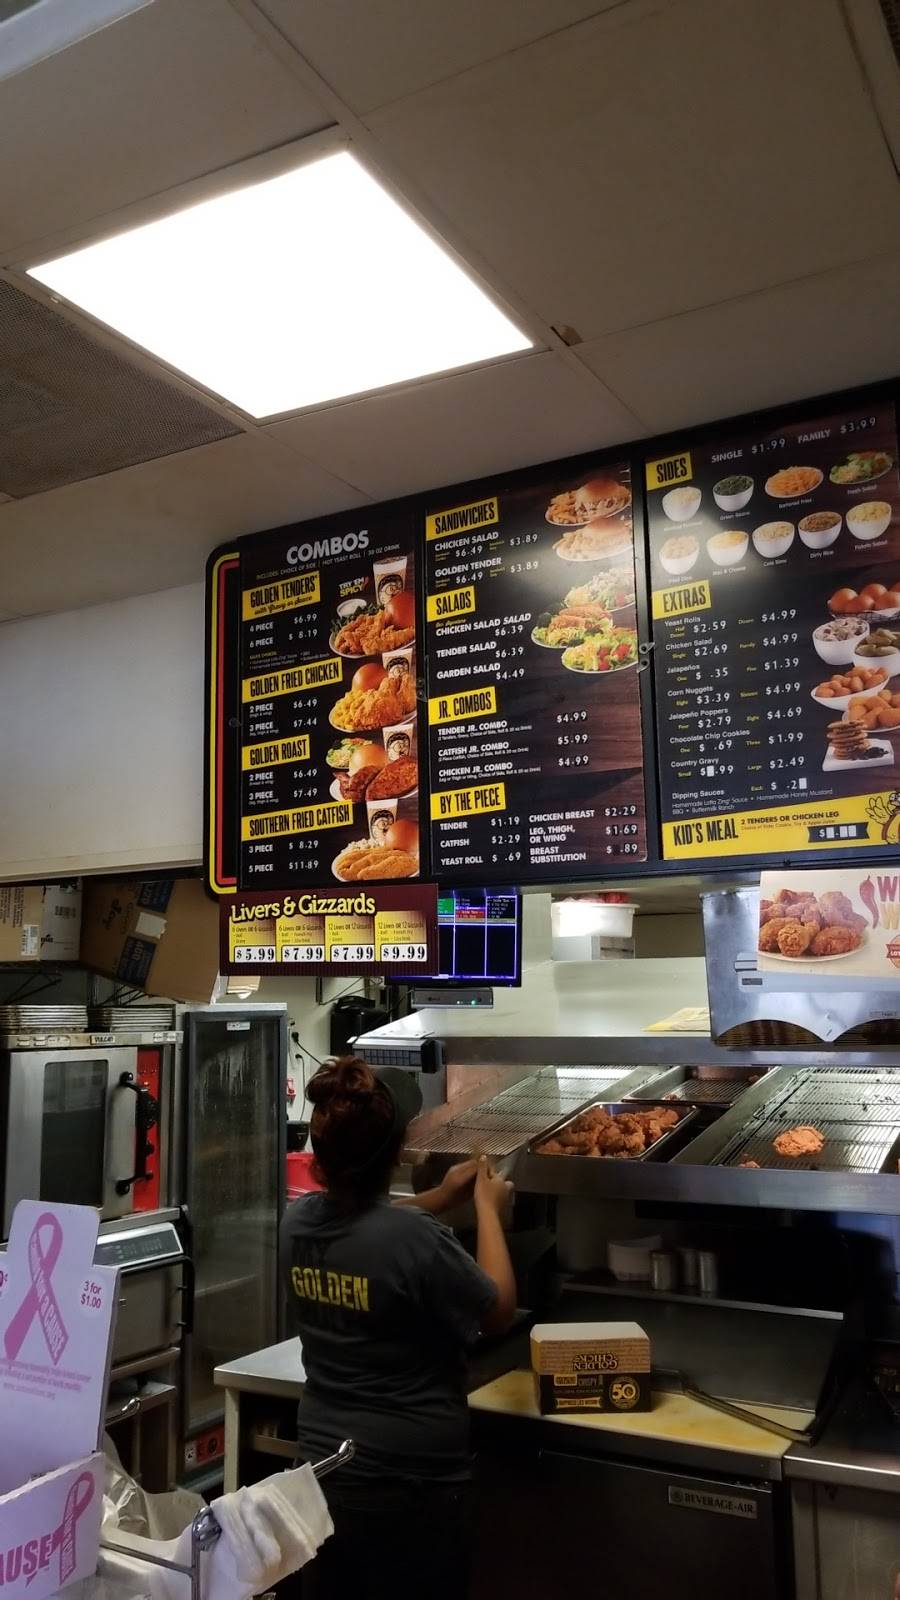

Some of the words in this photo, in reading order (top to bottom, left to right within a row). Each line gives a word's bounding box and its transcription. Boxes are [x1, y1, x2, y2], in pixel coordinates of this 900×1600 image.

[656, 457, 688, 484] SIDES
[711, 449, 743, 464] SINGLE
[751, 438, 786, 455] $1.99
[798, 429, 831, 444] FAMILY
[840, 416, 876, 434] $3.99
[434, 502, 496, 535] SANDWICHES
[434, 537, 470, 551] CHICKEN
[471, 531, 499, 544] SALAD
[509, 533, 538, 546] $3.89
[286, 530, 369, 565] COMBOS
[455, 545, 483, 557] $6.49
[434, 564, 469, 577] GOLDEN
[470, 557, 502, 570] TENDER
[510, 560, 539, 574] $3.89
[455, 572, 483, 584] $6.49
[250, 584, 280, 608] GOLDEN
[436, 591, 471, 616] SALADS
[663, 587, 707, 614] EXTRAS
[249, 625, 254, 633] 4
[255, 622, 274, 632] PIECE
[294, 613, 317, 624] $6.99
[436, 624, 472, 637] CHICKEN
[473, 618, 501, 630] SALAD
[503, 612, 532, 625] SALAD
[664, 619, 683, 627] Yeast
[683, 616, 701, 624] Rolls
[693, 620, 727, 633] $2.59
[761, 609, 797, 623] $4.99
[495, 625, 523, 637] $6.39
[255, 637, 274, 647] PIECE
[436, 646, 467, 658] TENDER
[469, 641, 497, 653] SALAD
[665, 641, 692, 650] Chicken
[694, 638, 712, 646] Salad
[694, 643, 728, 656] $2.69
[763, 633, 798, 647] $4.99
[495, 646, 524, 659] $6.39
[436, 667, 471, 680] GARDEN
[473, 663, 501, 674] SALAD
[764, 657, 799, 671] $1.39
[250, 675, 280, 697] GOLDEN
[281, 669, 303, 691] FRIED
[304, 661, 340, 685] CHICKEN
[496, 668, 525, 680] $4.49
[667, 689, 684, 697] Corn
[685, 686, 714, 695] Nuggets
[696, 692, 730, 704] $3.39
[766, 682, 800, 696] $4.99
[255, 703, 274, 712] PIECE
[293, 698, 317, 709] $6.49
[438, 700, 452, 719] JR.
[453, 691, 492, 716] COMBOS
[700, 707, 728, 717] Poppers
[255, 722, 274, 731] PIECE
[293, 717, 317, 728] $7.44
[438, 725, 466, 736] TENDER
[467, 724, 478, 733] JR.
[479, 720, 508, 730] COMBO
[556, 711, 588, 724] $4.99
[697, 715, 731, 728] $2.79
[767, 706, 802, 720] $4.69
[669, 734, 703, 744] Chocolate
[704, 731, 721, 740] Chip
[722, 729, 750, 738] Cookies
[768, 732, 803, 745] $1.99
[250, 745, 279, 766] GOLDEN
[281, 739, 307, 760] ROAST
[438, 746, 467, 757] CATFISH
[468, 745, 479, 753] JR.
[480, 741, 509, 752] COMBO
[557, 733, 589, 746] $5.99
[438, 766, 471, 777] CHICKEN
[472, 765, 483, 774] JR.
[484, 761, 513, 772] COMBO
[558, 755, 590, 767] $4.99
[670, 760, 697, 769] Country
[698, 757, 719, 766] Gravy
[769, 755, 804, 769] $2.49
[255, 772, 273, 780] PIECE
[293, 768, 317, 779] $6.49
[255, 791, 273, 799] PIECE
[293, 788, 317, 798] $7.49
[440, 794, 452, 814] BY
[454, 791, 472, 812] THE
[474, 787, 501, 809] PIECE
[672, 792, 698, 800] Dipping
[699, 789, 725, 797] Sauces
[249, 814, 290, 837] SOUTHERN
[292, 809, 315, 829] FRIED
[316, 803, 350, 826] CATFISH
[529, 812, 564, 823] CHICKEN
[565, 809, 595, 820] BREAST
[605, 805, 637, 817] $2.29
[747, 816, 778, 825] TENDERS
[779, 814, 790, 822] OR
[792, 812, 825, 821] CHICKEN
[439, 821, 468, 831] TENDER
[490, 816, 520, 827] $1.19
[529, 826, 547, 836] LEG,
[547, 824, 576, 835] THIGH,
[605, 825, 638, 836] $1.69
[529, 835, 542, 844] OR
[543, 833, 567, 842] WING
[673, 822, 704, 847] KID'S
[706, 818, 739, 842] MEAL
[255, 844, 274, 853] PIECE
[440, 838, 470, 848] CATFISH
[491, 834, 521, 844] $2.29
[530, 846, 560, 856] BREAST
[530, 852, 587, 864] SUBSTITUTION
[249, 865, 254, 873] 5
[255, 863, 274, 872] PIECE
[289, 860, 319, 870] $11.89
[441, 856, 464, 866] YEAST
[464, 855, 484, 864] ROLL
[231, 903, 280, 922] Livers
[283, 896, 296, 916] &
[298, 892, 375, 915] Gizzards
[236, 948, 275, 961] $5.99
[284, 947, 323, 961] $7.99
[333, 946, 373, 961] $7.99
[383, 945, 426, 960] $9.99
[84, 1281, 89, 1292] 3
[89, 1282, 102, 1295] for
[291, 1266, 369, 1312] GOLDEN
[80, 1294, 102, 1310] $1.00
[573, 1360, 618, 1370] GOLDEN
[611, 1383, 636, 1400] 50
[684, 1492, 754, 1514] BEVERAGE-AIR
[0, 1533, 52, 1586] USE
